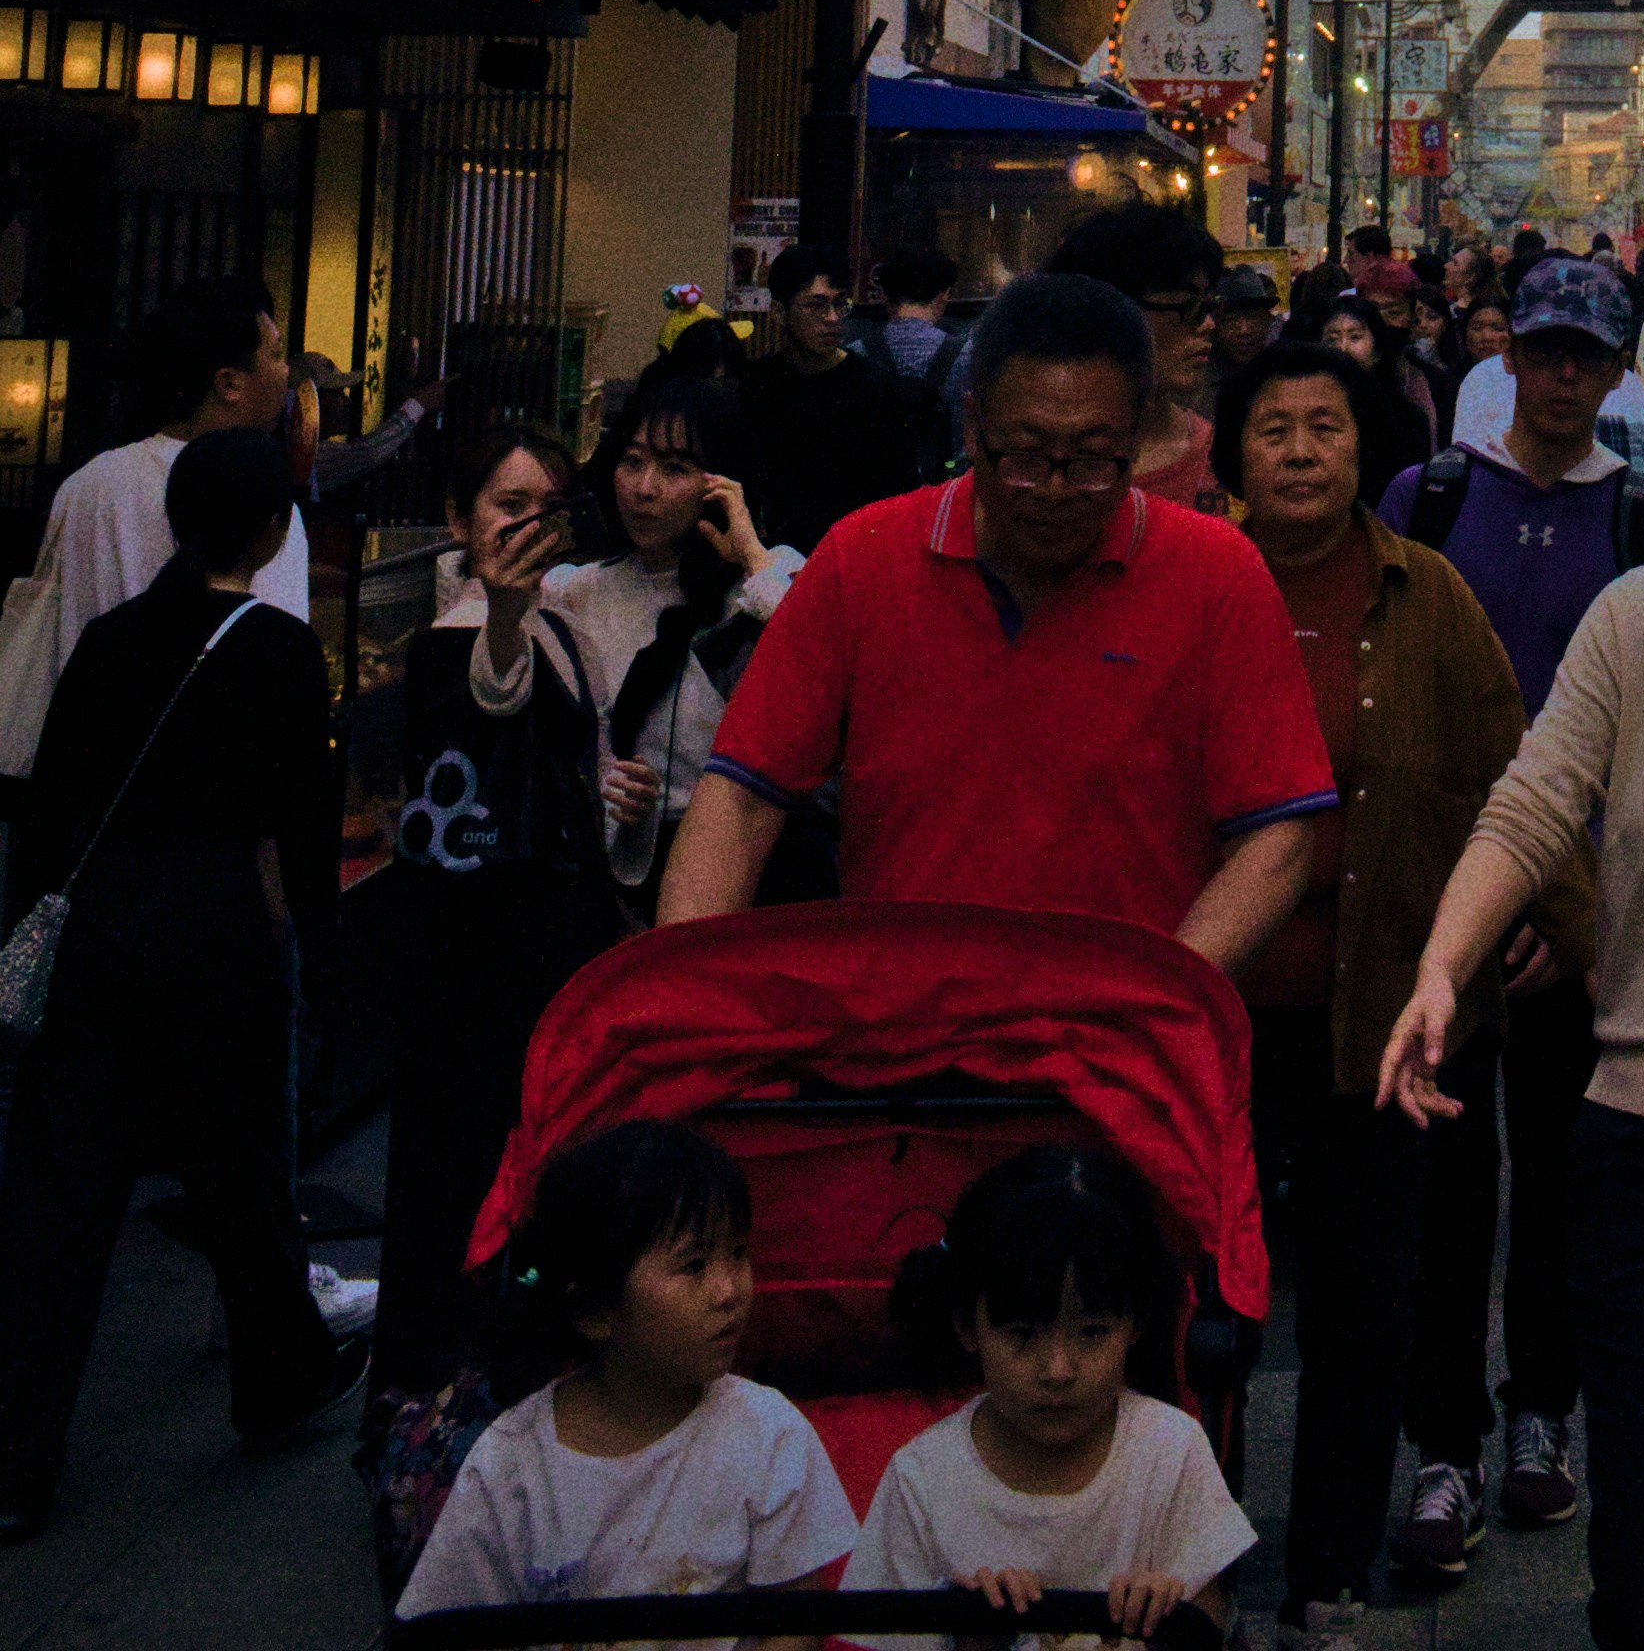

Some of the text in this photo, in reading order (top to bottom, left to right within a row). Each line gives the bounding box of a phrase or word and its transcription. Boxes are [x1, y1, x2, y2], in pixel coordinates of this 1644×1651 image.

[1164, 43, 1243, 75] 鶴亀家
[462, 827, 499, 846] and
